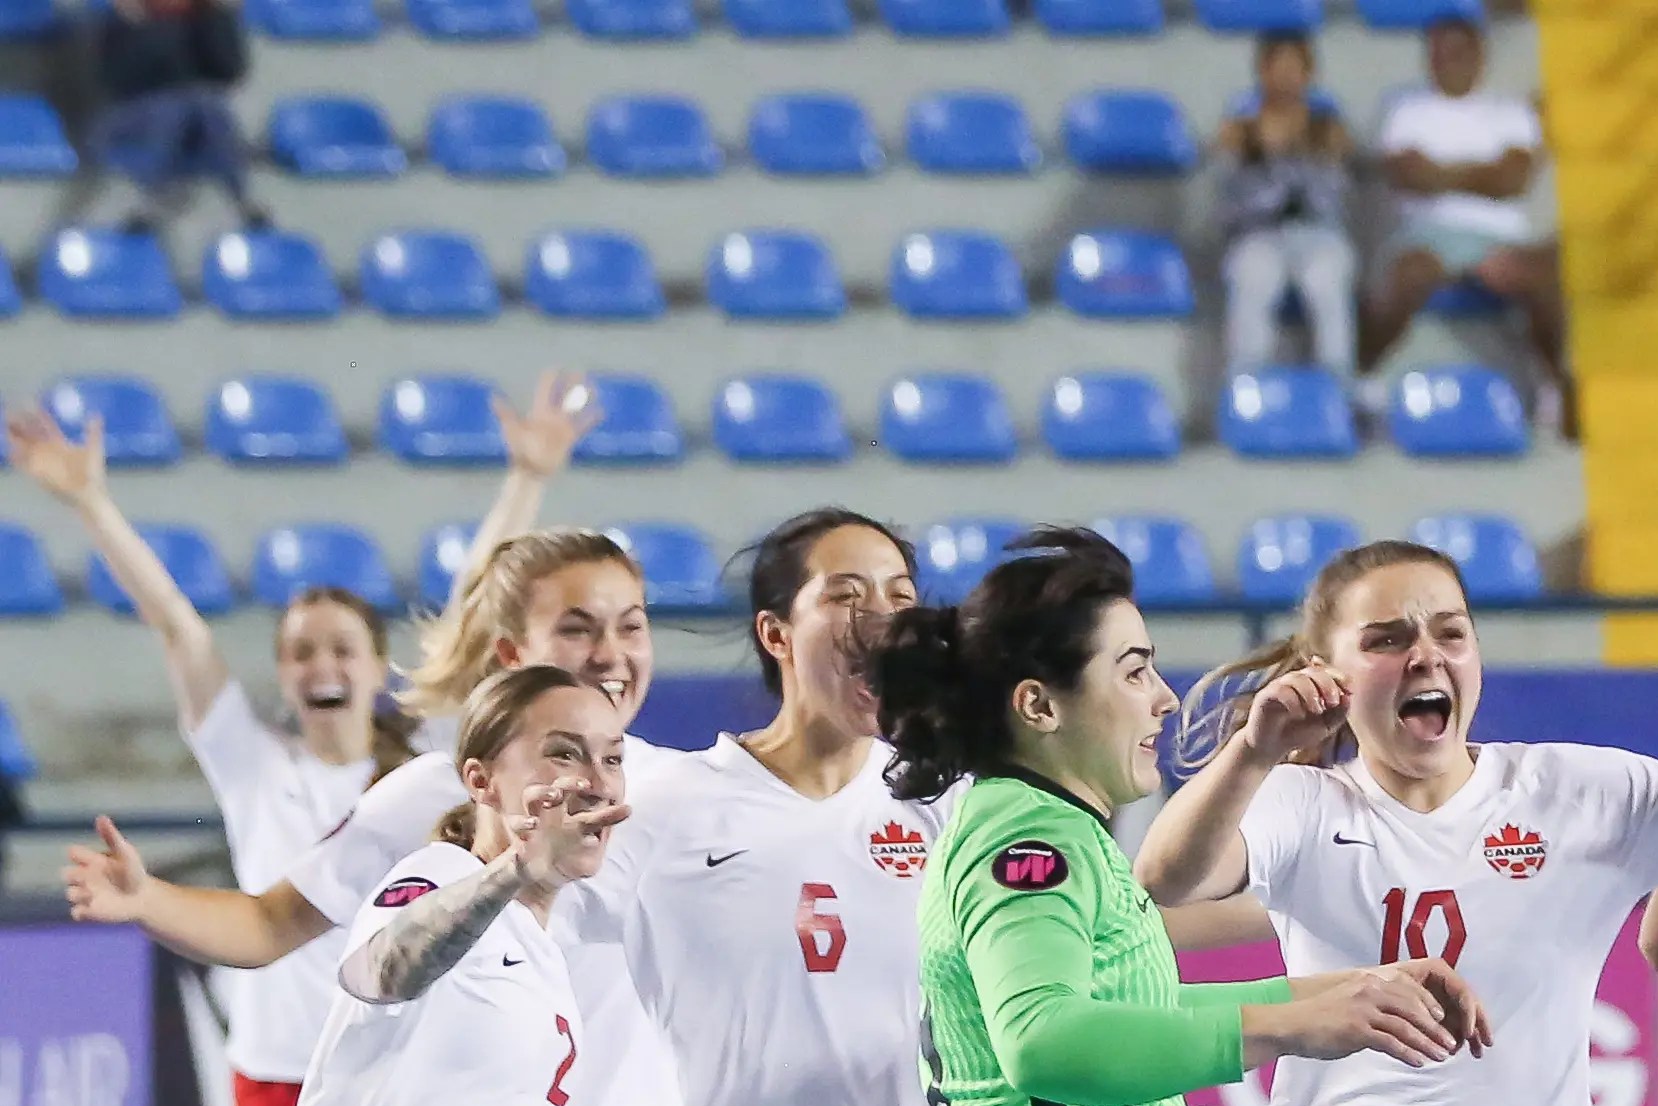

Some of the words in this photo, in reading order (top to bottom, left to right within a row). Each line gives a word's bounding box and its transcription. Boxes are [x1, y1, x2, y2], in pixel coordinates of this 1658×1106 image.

[870, 845, 927, 854] CANADA
[1484, 845, 1546, 857] CANADA
[796, 883, 847, 972] 6
[1379, 887, 1467, 970] 10
